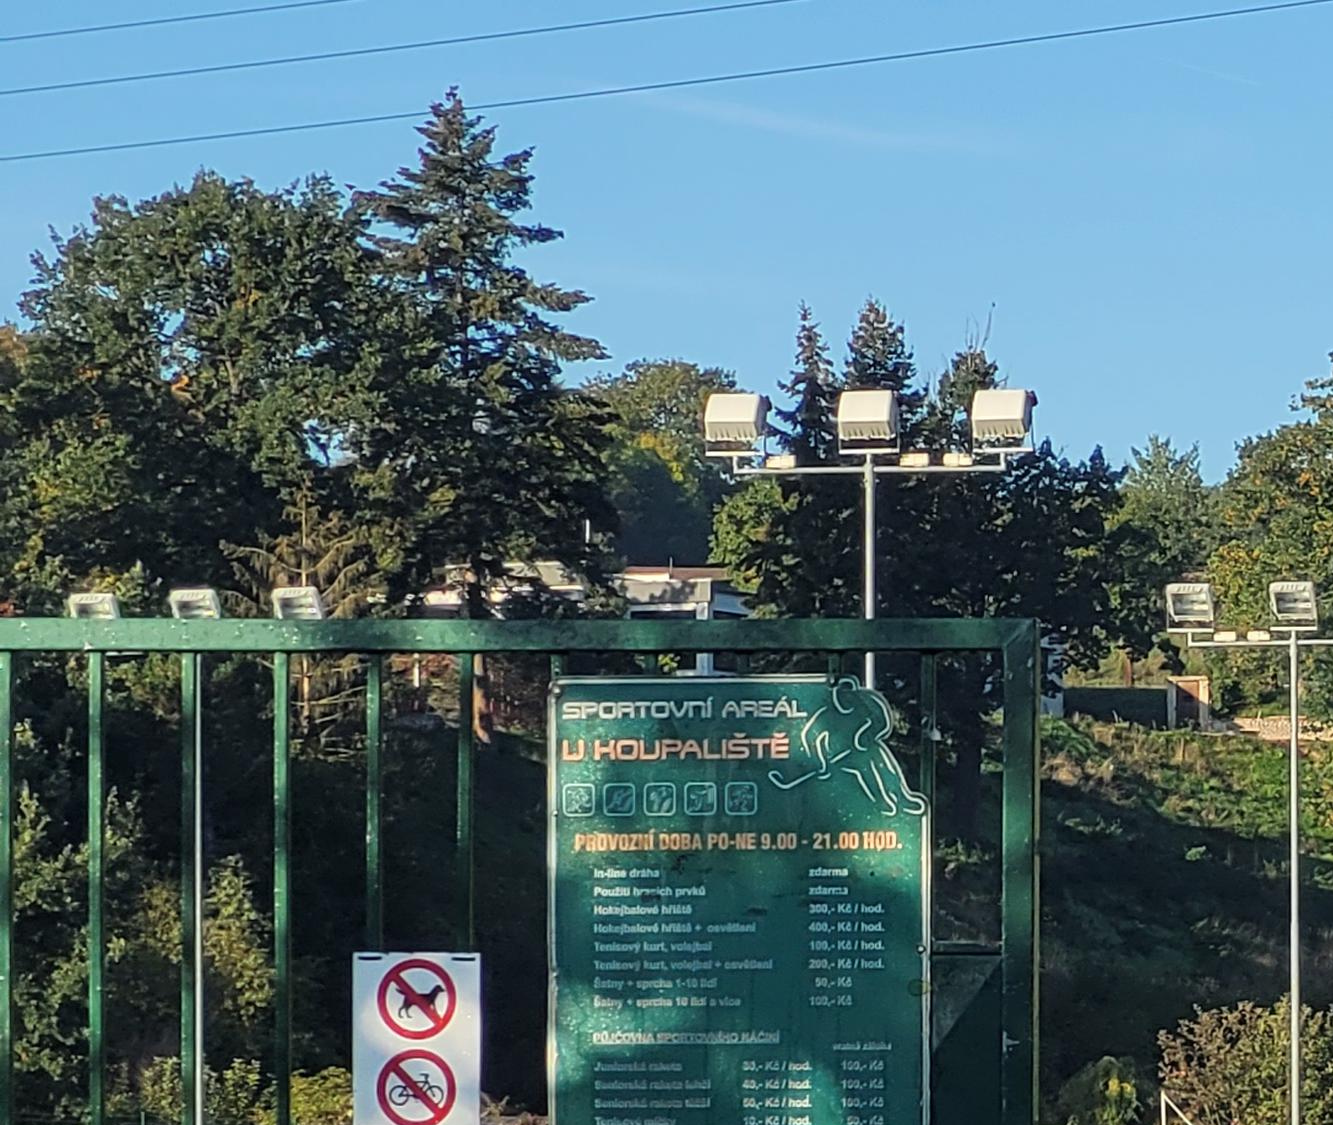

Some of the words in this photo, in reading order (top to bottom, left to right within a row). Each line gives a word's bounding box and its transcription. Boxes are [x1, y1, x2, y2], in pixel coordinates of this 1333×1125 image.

[562, 696, 713, 720] SPORTOVNÍ
[721, 695, 808, 719] AREÁL
[562, 740, 585, 762] U
[593, 733, 790, 761] KOUPALIŠTĚ
[574, 829, 654, 852] PROVOZNÍ
[659, 832, 702, 851] DOBA
[708, 832, 757, 851] PO-NE
[761, 832, 797, 851] 9.00
[812, 832, 859, 851] 21.00
[863, 831, 903, 851] HOD.
[808, 866, 849, 877] zdarma
[594, 904, 659, 917] Hokejbalové
[837, 903, 853, 914] Kč
[861, 903, 885, 914] hod.
[837, 921, 853, 932] Kč
[861, 921, 885, 932] hod.
[594, 941, 640, 954] Tenisový
[643, 941, 668, 953] kurt,
[837, 940, 853, 951] Kč
[861, 940, 885, 951] hod.
[837, 958, 853, 969] Kč
[861, 958, 885, 969] hod.
[837, 976, 853, 987] Kč
[837, 995, 853, 1006] Kč
[788, 1060, 812, 1070] hod.
[788, 1079, 812, 1089] hod.
[788, 1097, 812, 1107] hod.
[788, 1116, 812, 1125] hod.
